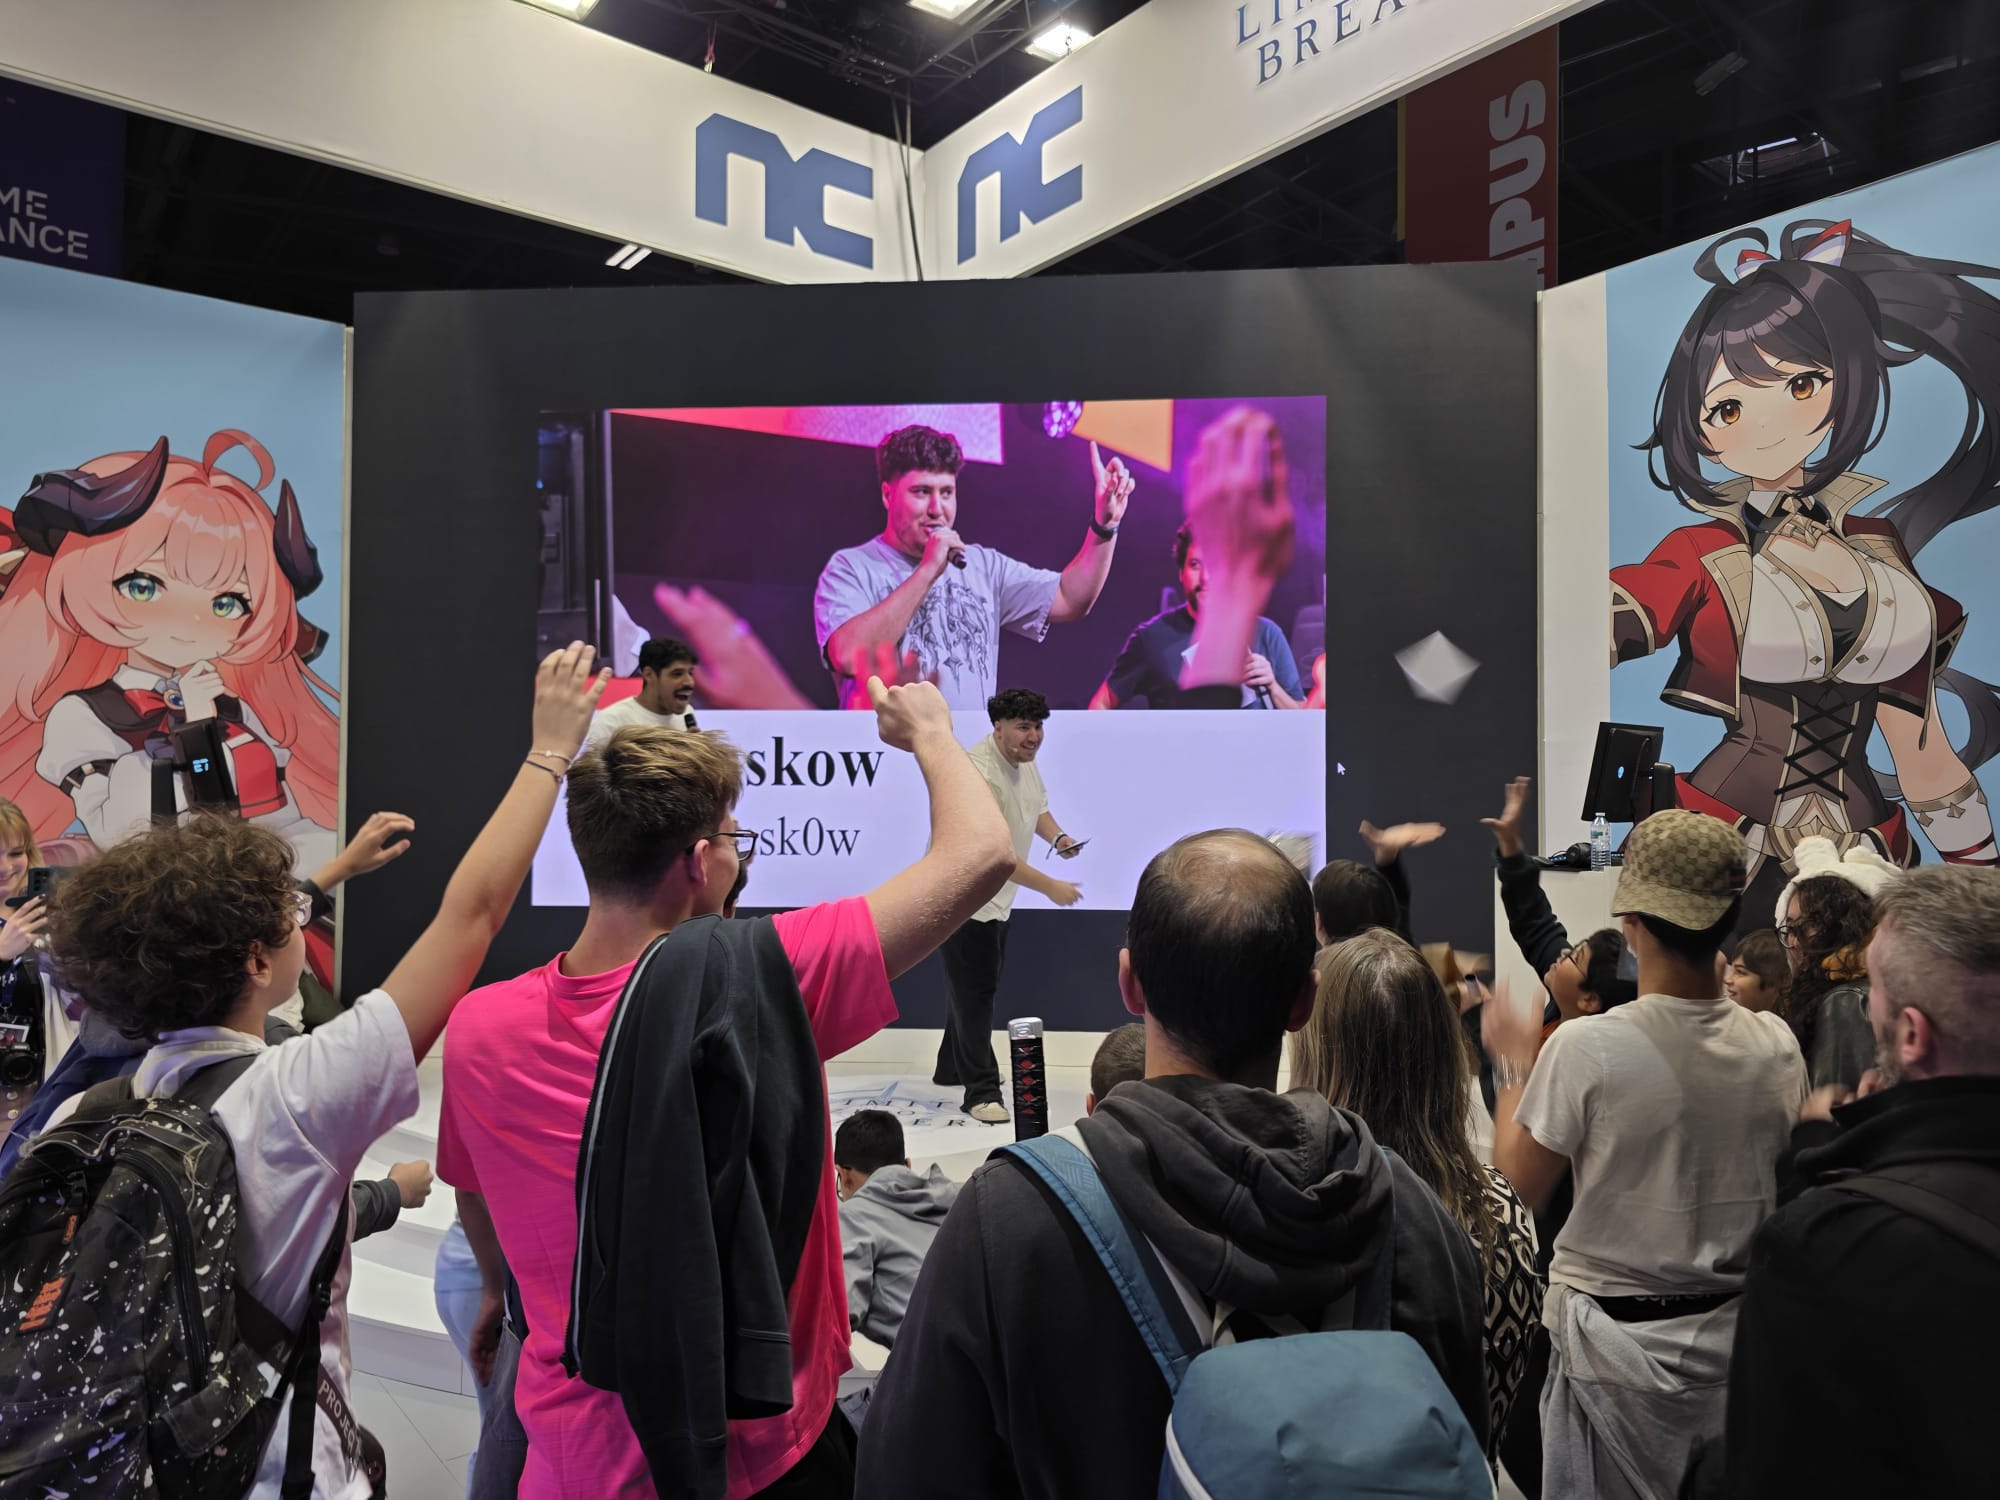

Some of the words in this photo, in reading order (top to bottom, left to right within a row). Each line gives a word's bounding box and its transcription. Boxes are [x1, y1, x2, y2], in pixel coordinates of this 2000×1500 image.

[1489, 79, 1546, 290] PUS
[0, 216, 89, 260] NCE
[746, 736, 884, 787] skow
[752, 815, 861, 856] sk0w
